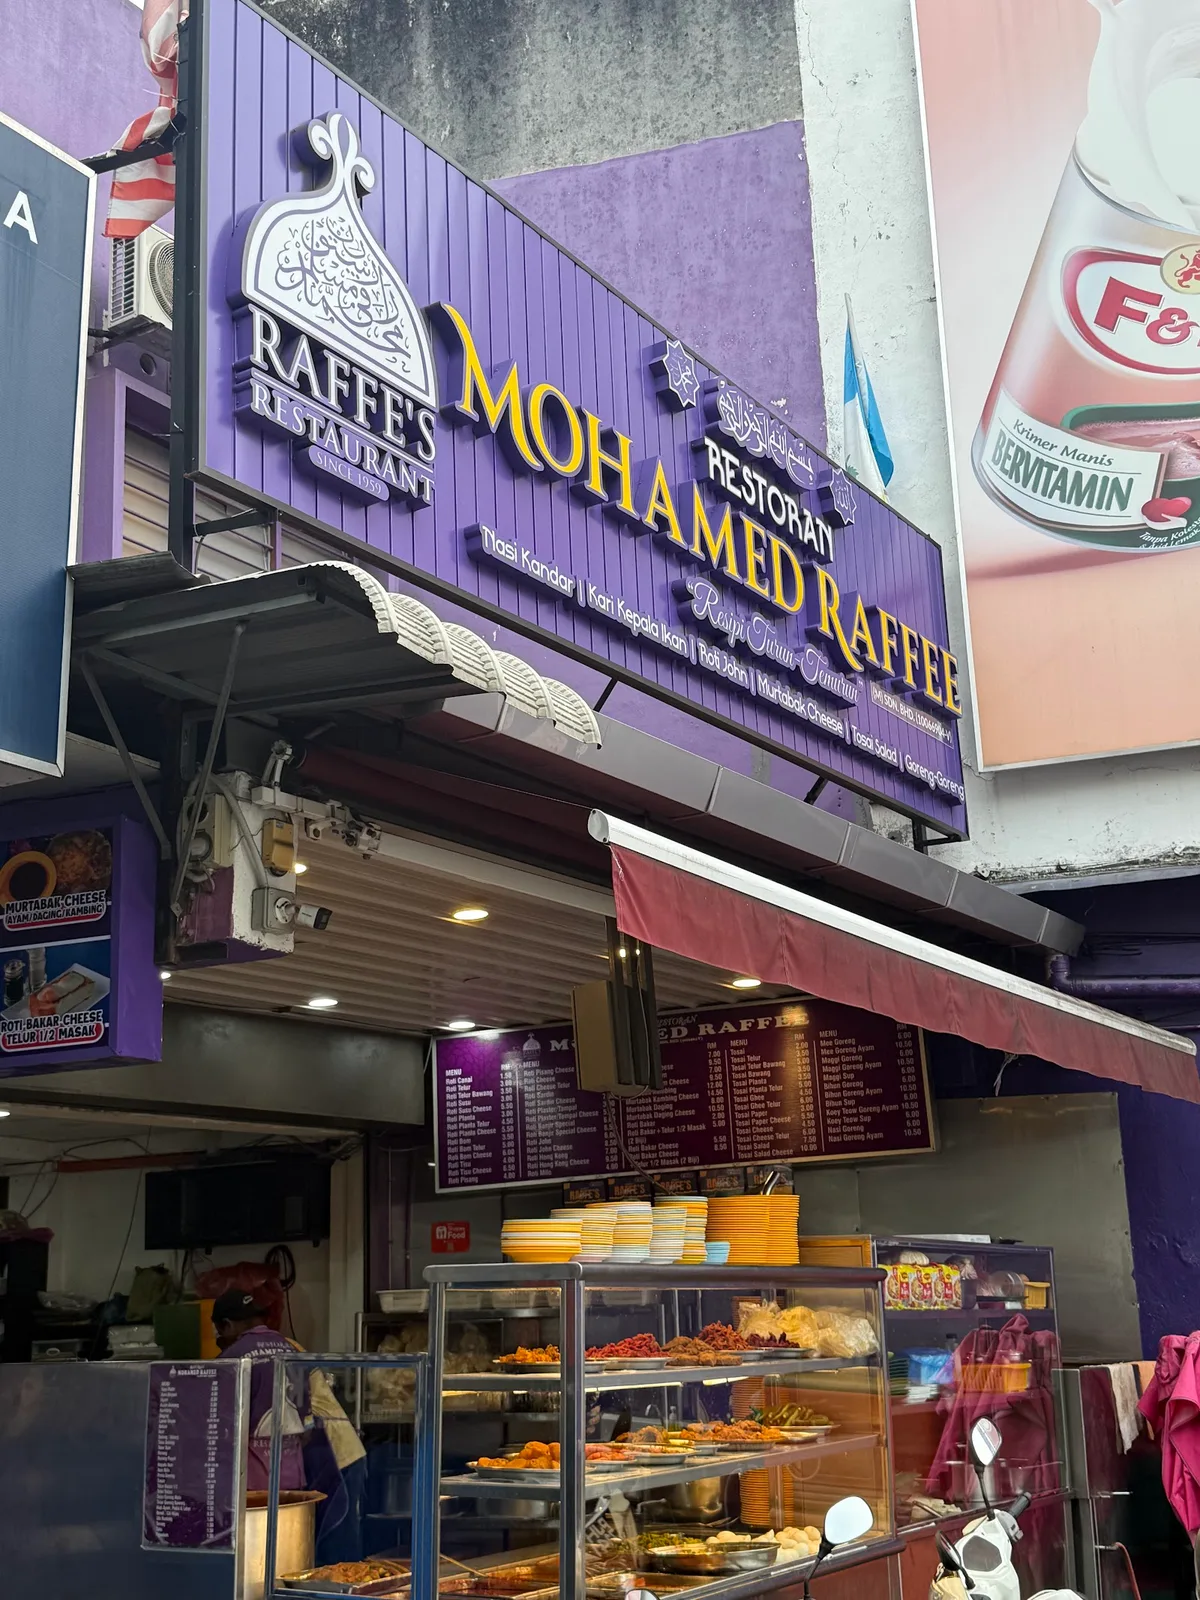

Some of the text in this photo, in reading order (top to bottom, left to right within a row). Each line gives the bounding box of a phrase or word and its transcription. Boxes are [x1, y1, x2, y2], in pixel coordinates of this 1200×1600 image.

[3, 190, 38, 244] A
[1094, 276, 1200, 346] F&
[248, 304, 436, 464] RAFFE'S
[250, 380, 435, 503] RESTAURANT
[1013, 419, 1114, 467] Krimer Manis
[316, 450, 383, 495] SINCE 1959
[992, 428, 1133, 512] BERVITAMIN
[442, 302, 962, 715] MOHAMED RAFFEE
[704, 436, 833, 562] RESTORAN
[1139, 532, 1168, 545] Tanpa
[482, 525, 965, 801] Nasi Kandar Kari Kepala Ikan Roti John Murtabak Cheese Tosai Salad Goreng-Goreng
[872, 686, 883, 704] (M)
[884, 694, 899, 713] SDN.
[900, 703, 915, 722] BHD.
[5, 891, 105, 914] MURTABAK CHEESE
[5, 903, 105, 925] (AYAM/DAGING/KAMBING)
[1, 1010, 102, 1033] ROTI BAKAR CHEESE
[6, 1023, 96, 1045] TELUR 1/2 MASAK
[697, 1012, 810, 1036] RAFFEE
[819, 1029, 837, 1038] MENU
[730, 1038, 747, 1047] MENU
[445, 1068, 461, 1076] MENU
